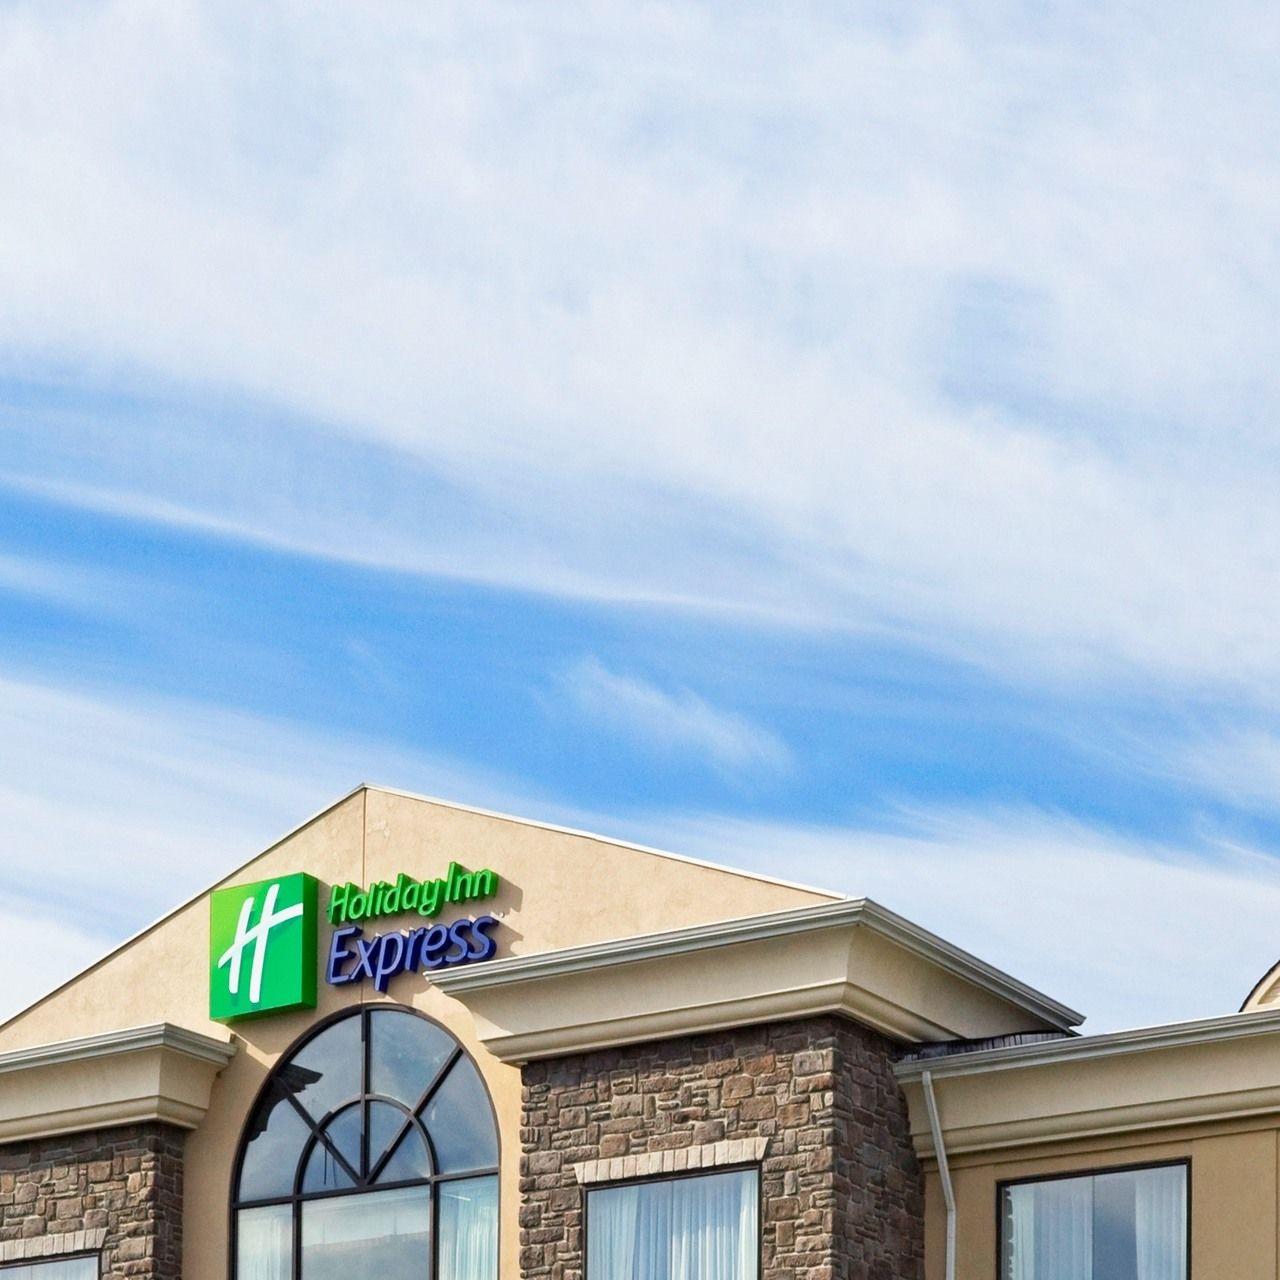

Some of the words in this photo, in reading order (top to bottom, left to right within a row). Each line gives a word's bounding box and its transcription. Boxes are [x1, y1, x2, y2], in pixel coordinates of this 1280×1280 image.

[327, 873, 445, 926] Holiday
[445, 861, 500, 904] Inn
[325, 915, 500, 993] Express
